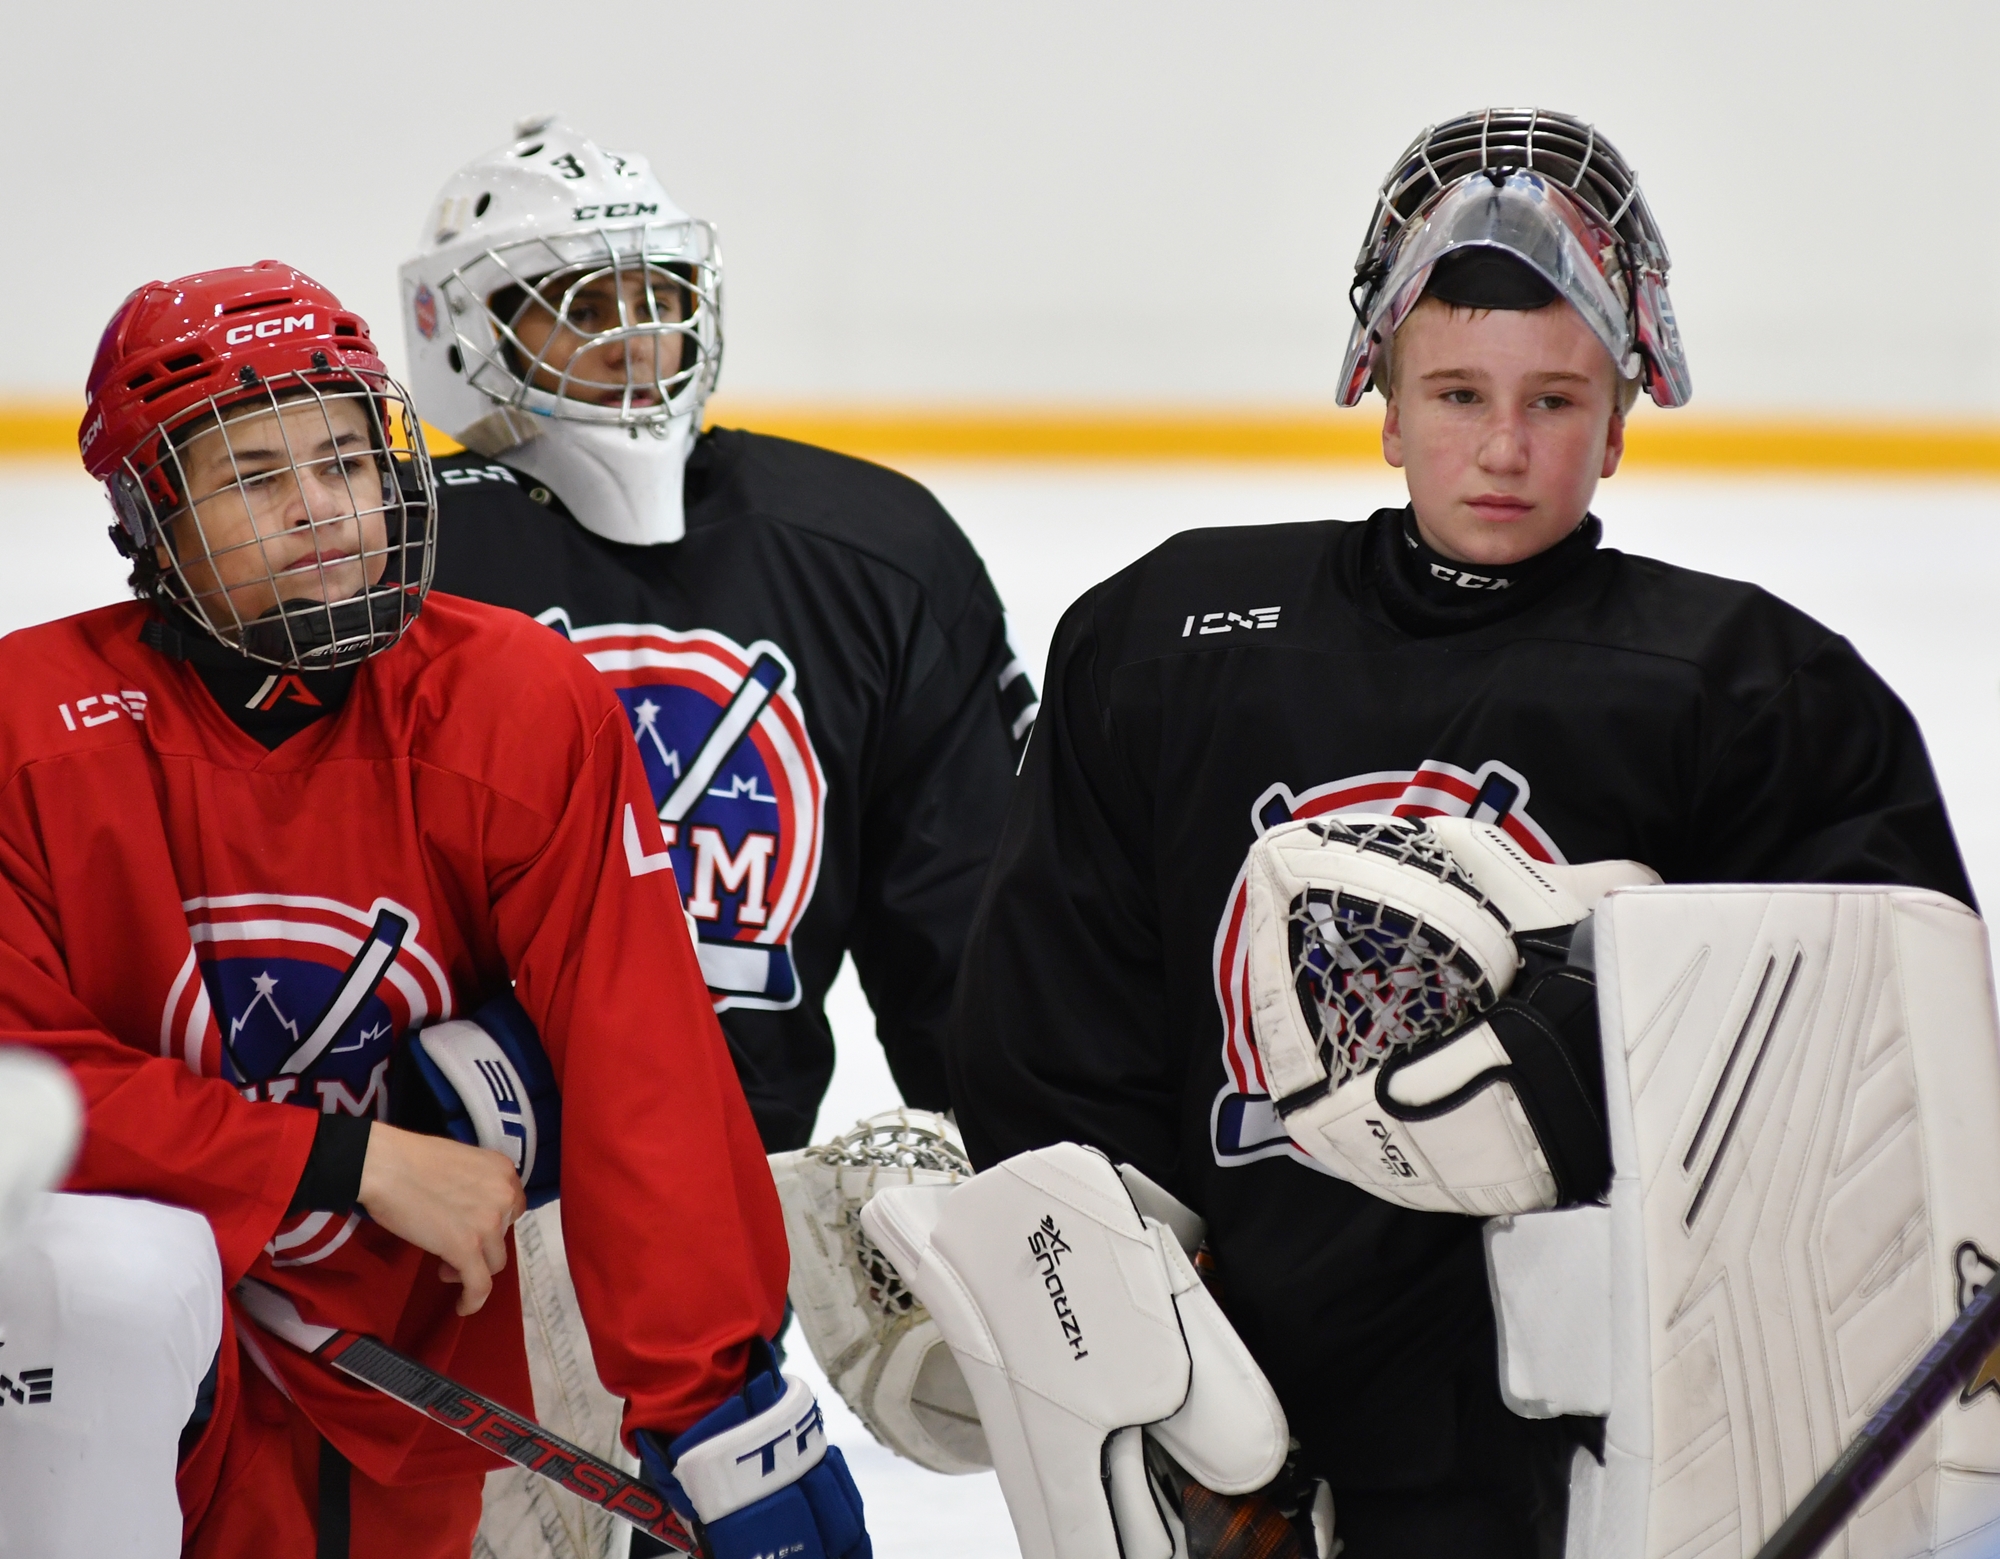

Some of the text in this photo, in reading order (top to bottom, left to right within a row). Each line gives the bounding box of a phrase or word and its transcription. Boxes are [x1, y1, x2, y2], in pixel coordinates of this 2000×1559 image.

[572, 203, 659, 221] CCM
[226, 313, 315, 346] CCM
[80, 412, 103, 457] CCM
[1027, 1231, 1089, 1361] HZRDUS
[425, 1396, 704, 1559] JETSPE
